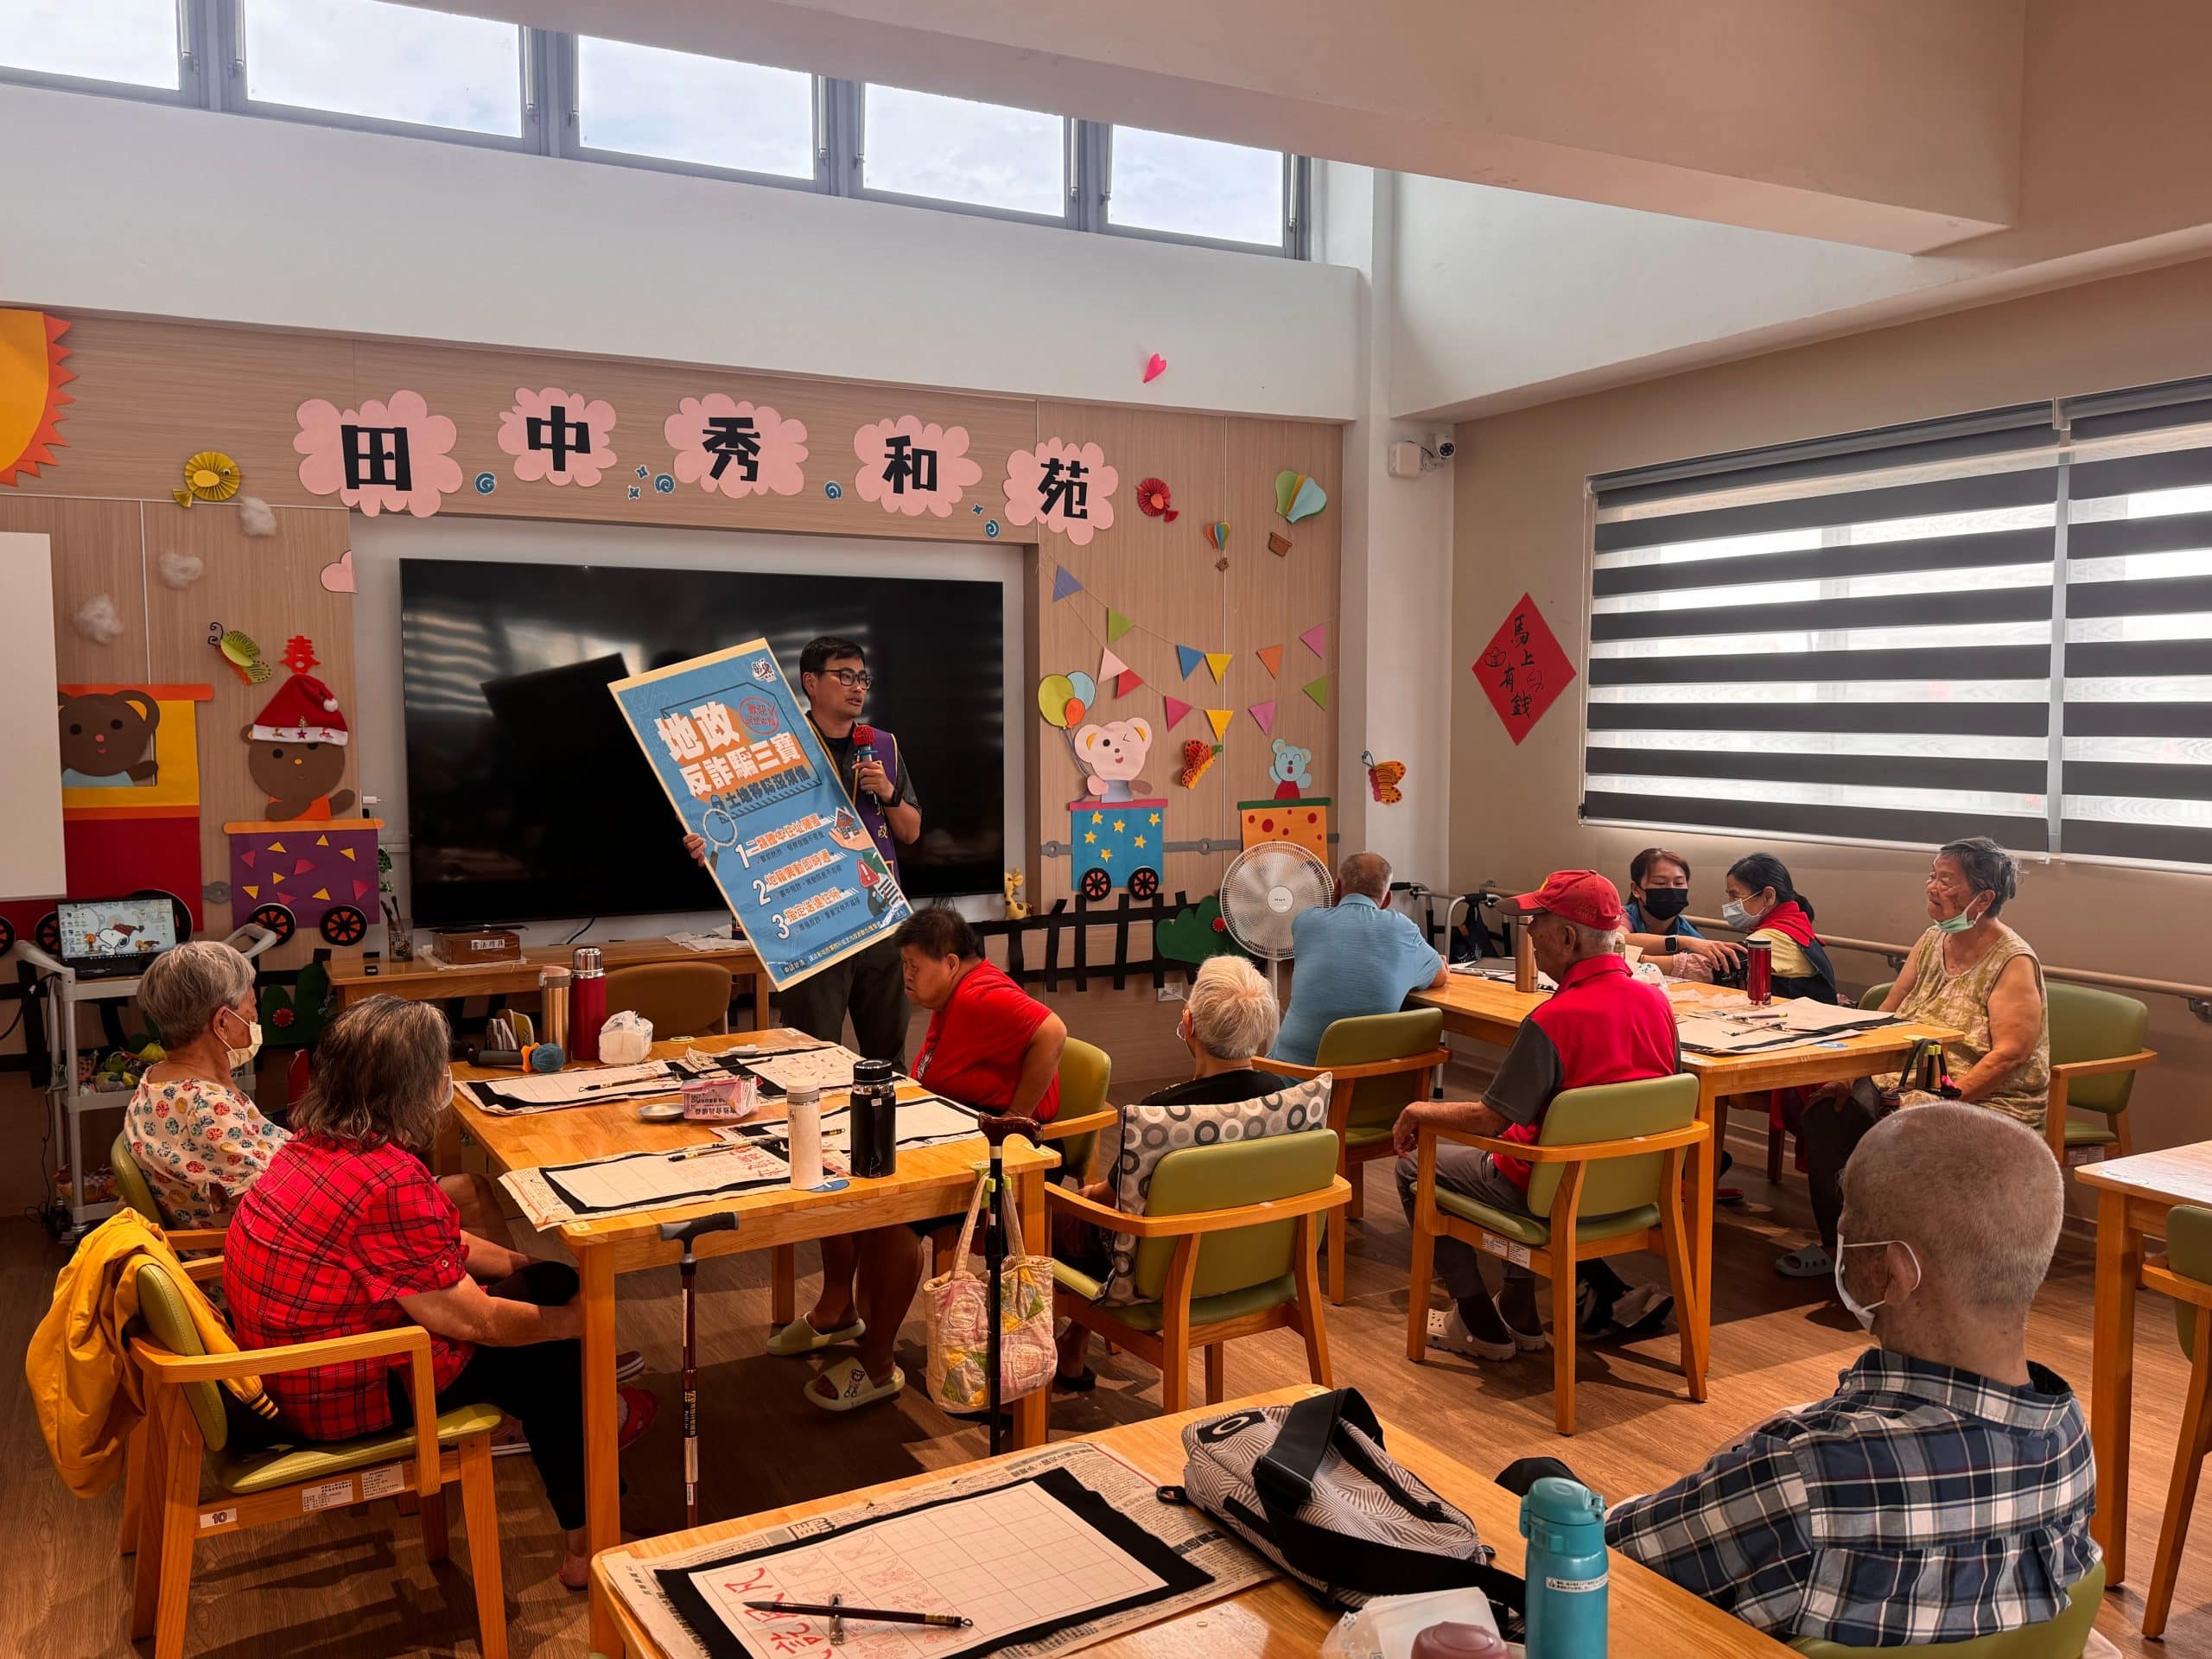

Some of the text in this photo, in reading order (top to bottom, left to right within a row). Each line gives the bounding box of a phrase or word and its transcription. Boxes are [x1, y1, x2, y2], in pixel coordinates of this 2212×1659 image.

[340, 405, 1090, 520] 田中秀和苑
[1499, 613, 1535, 718] 馬上有錢
[654, 701, 741, 762] 地政
[679, 732, 802, 798] 反詐騙三寶
[734, 844, 751, 869] 1
[753, 879, 771, 906] 2
[772, 913, 790, 940] 3
[212, 1511, 227, 1524] 10
